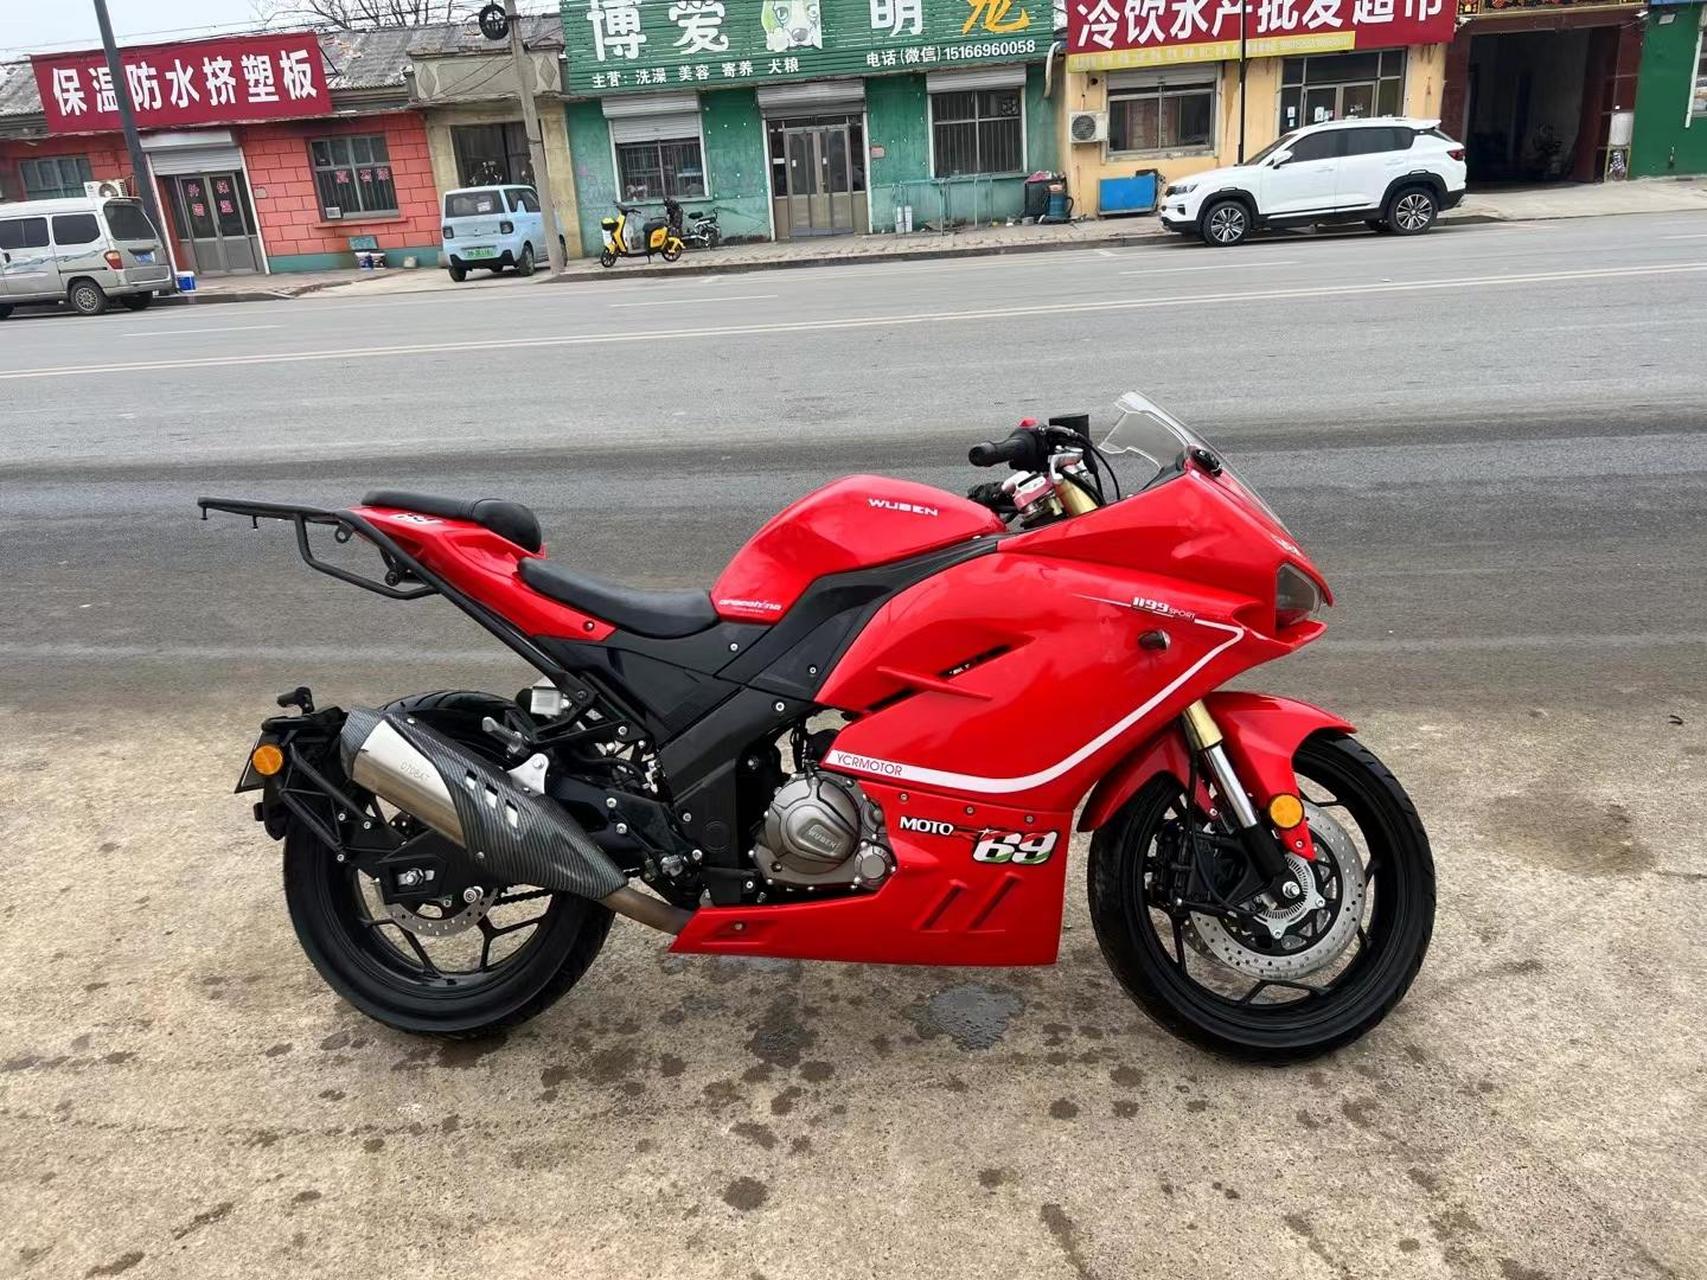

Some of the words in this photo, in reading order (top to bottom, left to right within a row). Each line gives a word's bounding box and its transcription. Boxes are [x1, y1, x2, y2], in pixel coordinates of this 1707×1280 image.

[53, 49, 318, 116] 保温防水挤塑板
[635, 67, 668, 85] 洗澡
[678, 64, 710, 81] 美容
[721, 60, 754, 77] 寄养
[767, 57, 800, 74] 犬粮
[867, 498, 939, 517] WUBEN
[836, 752, 903, 777] YCRMOTOR
[899, 815, 954, 836] MOTO
[972, 830, 1058, 865] 69
